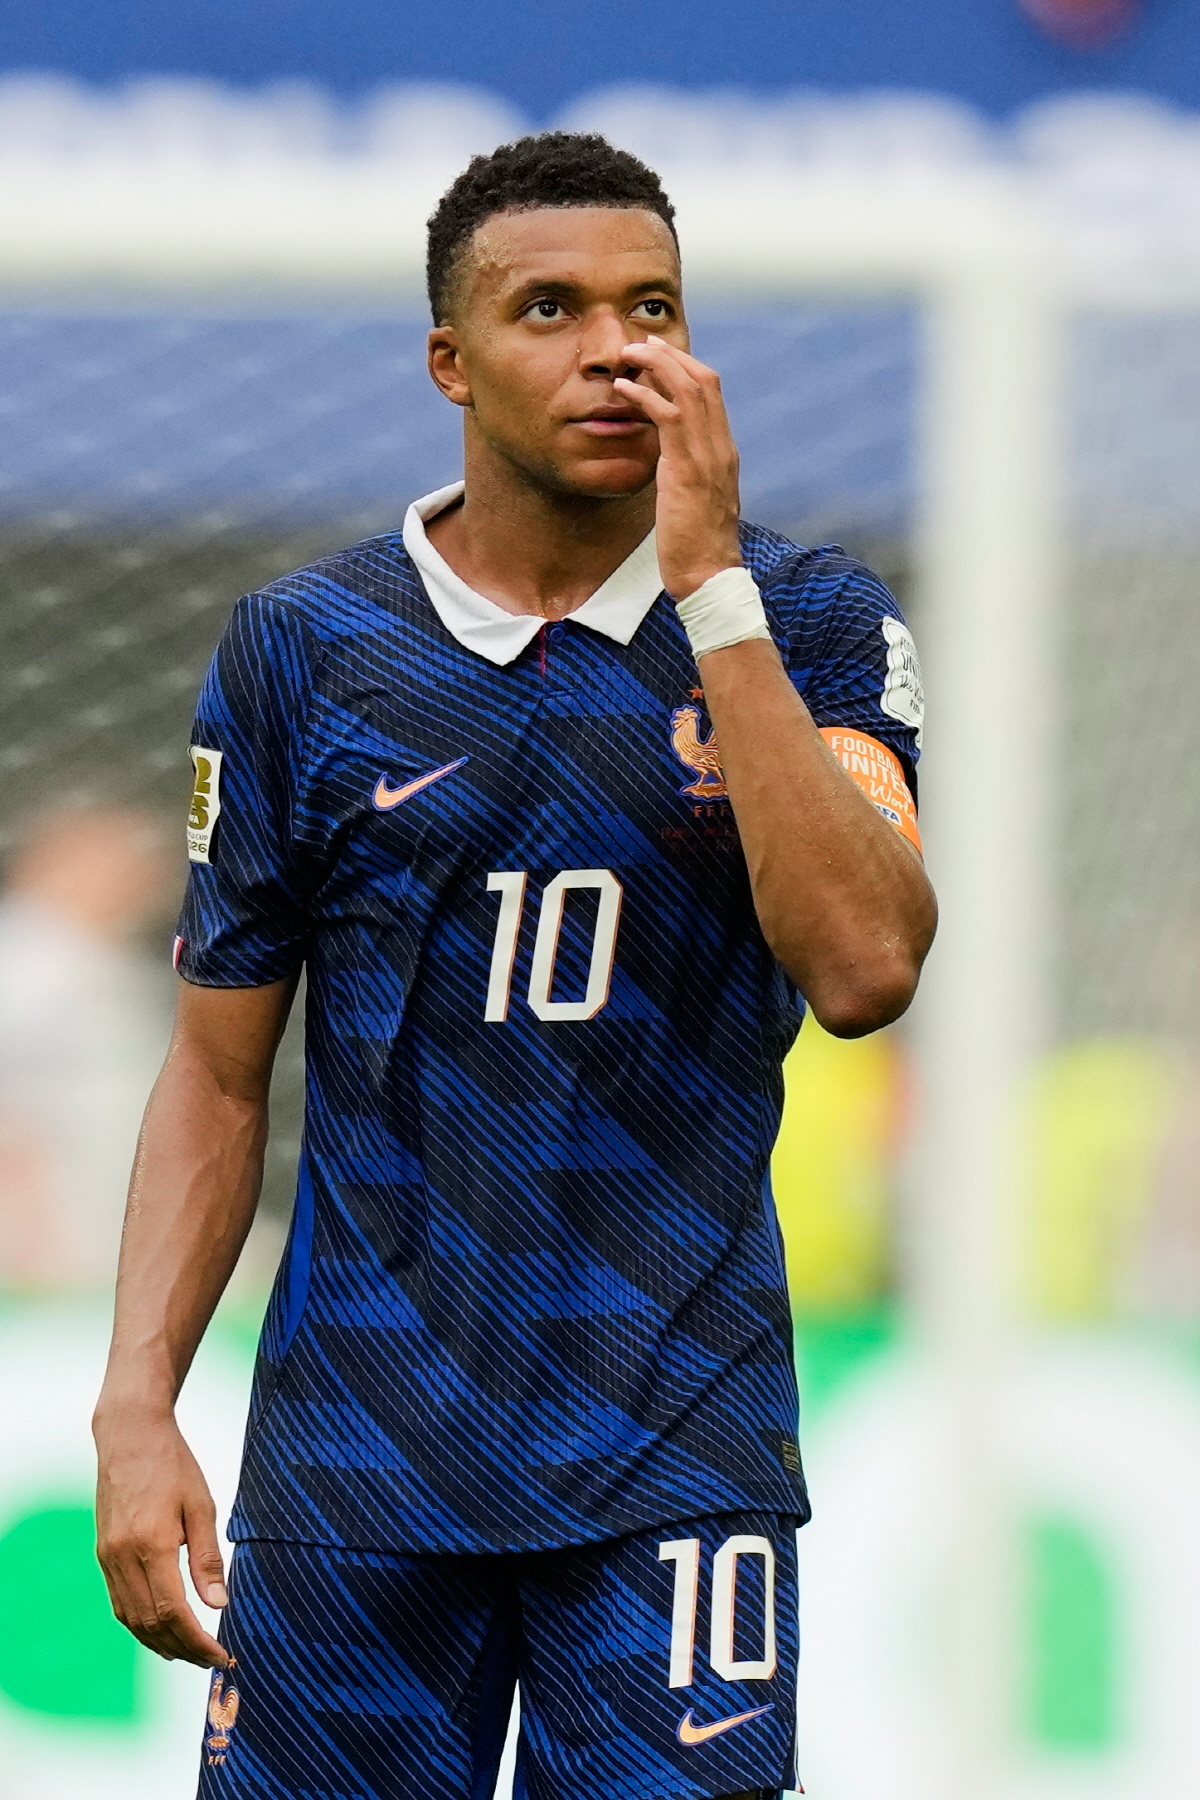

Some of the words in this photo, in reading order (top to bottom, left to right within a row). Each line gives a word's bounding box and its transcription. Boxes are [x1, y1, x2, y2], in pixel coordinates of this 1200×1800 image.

[831, 735, 901, 781] FOOTBALL
[484, 869, 624, 1022] 10
[658, 1535, 777, 1689] 10
